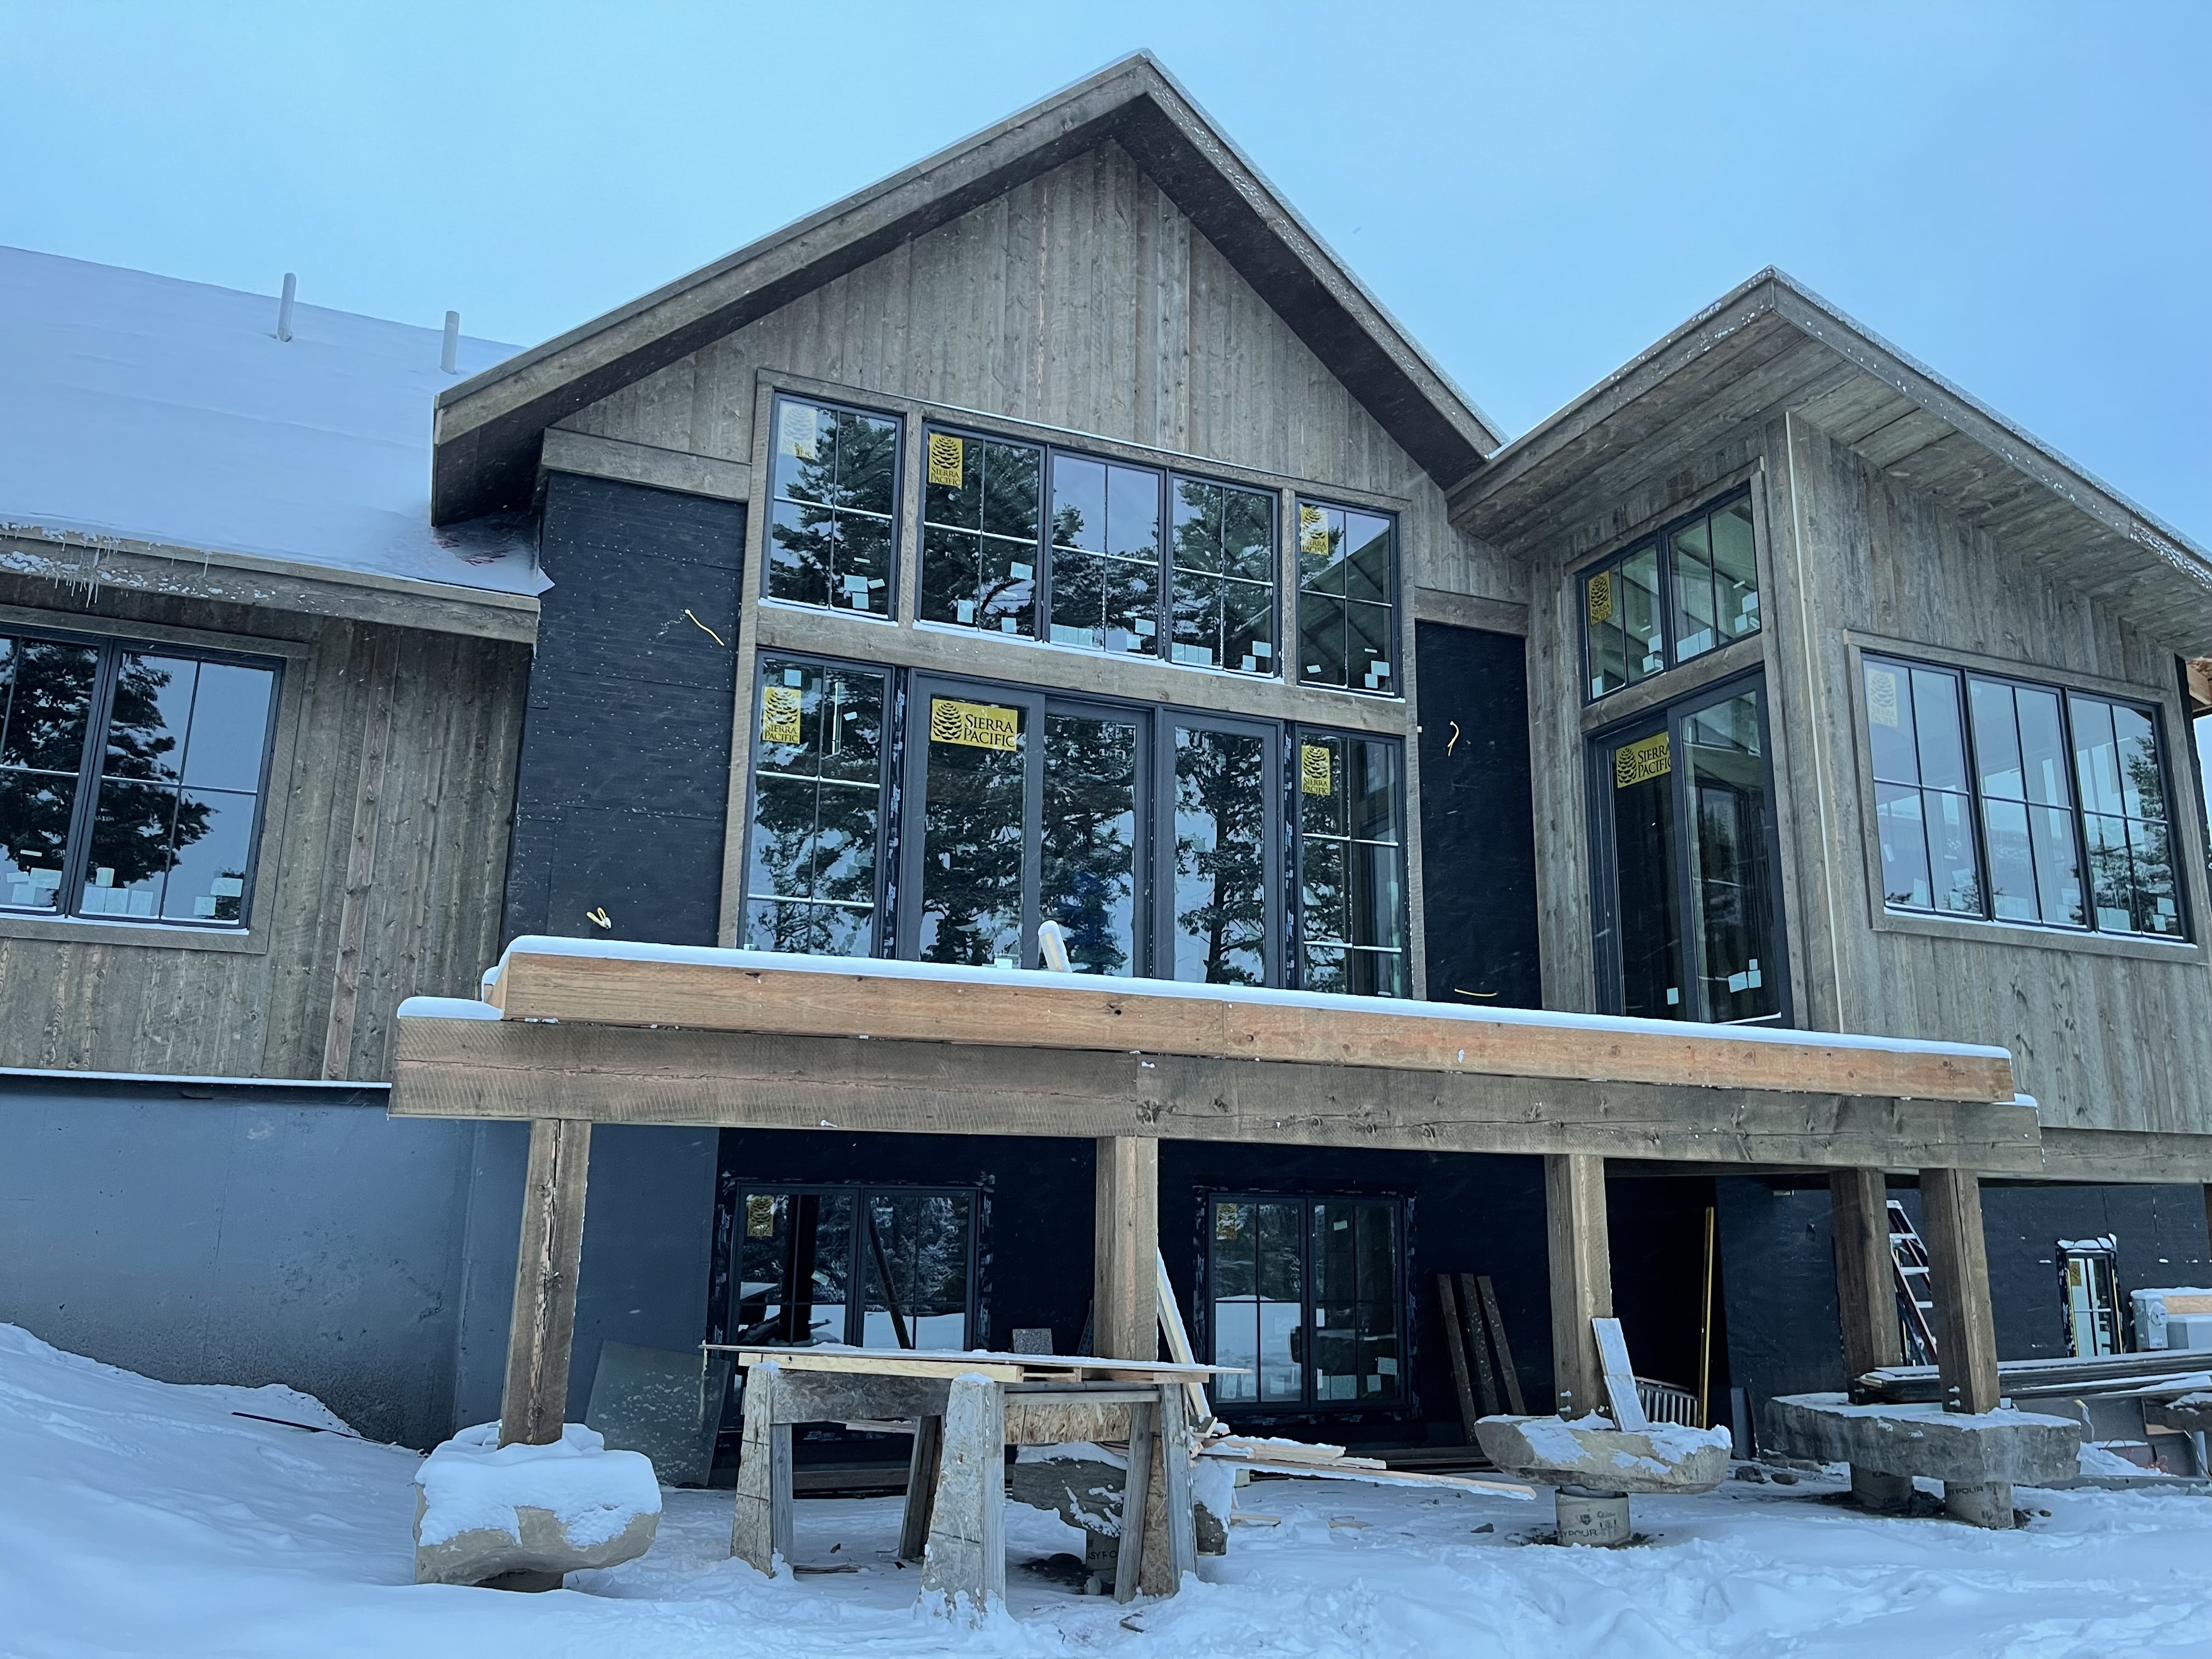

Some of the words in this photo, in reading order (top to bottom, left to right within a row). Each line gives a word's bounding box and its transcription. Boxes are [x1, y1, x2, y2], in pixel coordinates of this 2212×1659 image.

[932, 467, 960, 478] SIERRA
[930, 474, 961, 486] PACIFIC
[1305, 538, 1327, 548] IERRA
[1871, 705, 1895, 718] SIERRA
[765, 724, 797, 734] SIERRA
[964, 714, 1014, 733] SIERRA
[764, 731, 799, 742] PACIFIC
[963, 728, 1015, 747] PACIFIC
[1304, 777, 1328, 787] SIERRA
[1303, 784, 1329, 794] PACIFIC
